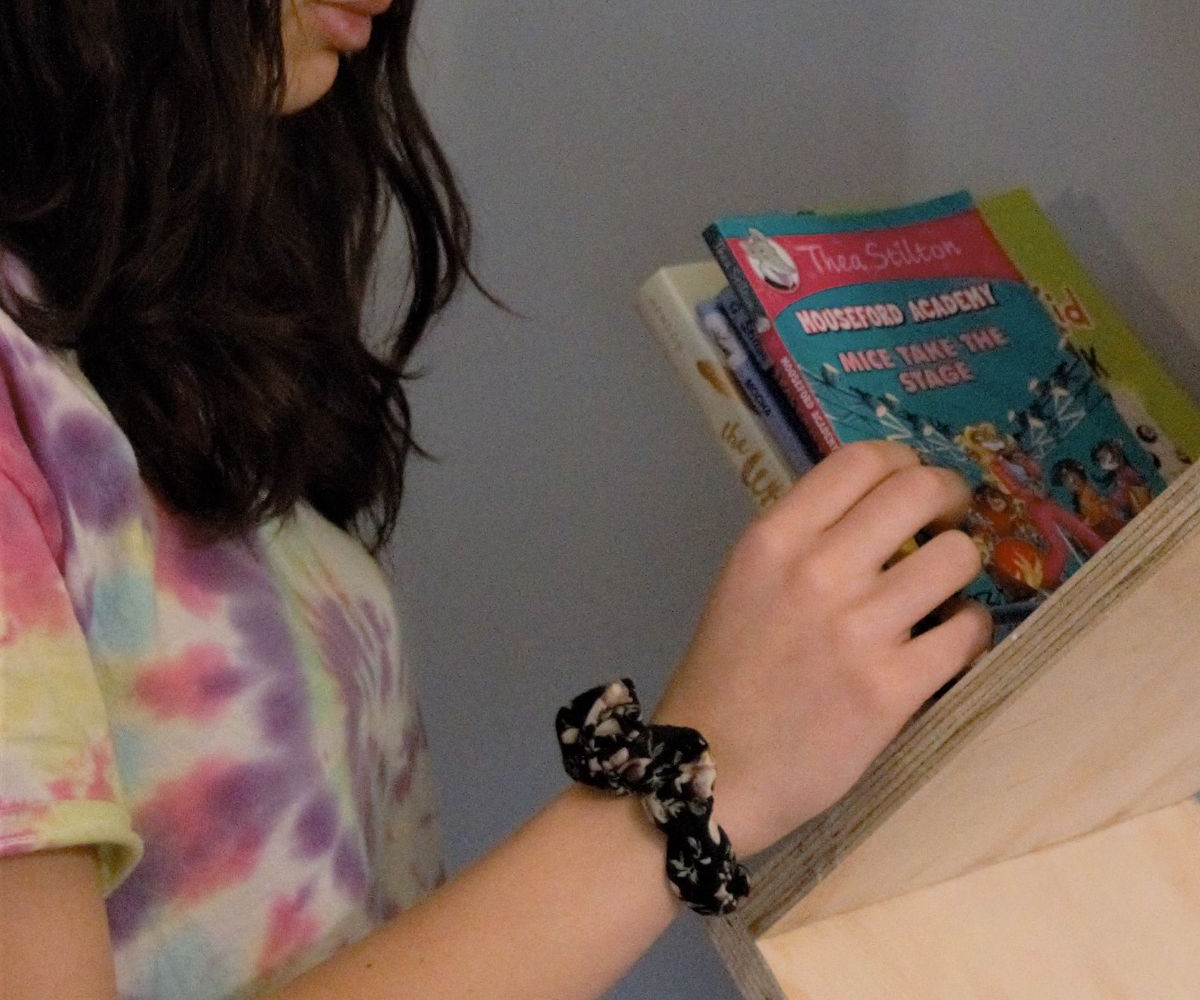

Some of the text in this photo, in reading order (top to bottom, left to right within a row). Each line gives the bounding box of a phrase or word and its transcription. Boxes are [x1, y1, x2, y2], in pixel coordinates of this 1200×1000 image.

[796, 240, 963, 276] Thea Stilton
[796, 283, 997, 335] MOUSEFORD ACADEMY
[838, 326, 1009, 373] MICE TAKE THE
[900, 361, 976, 393] STAGE
